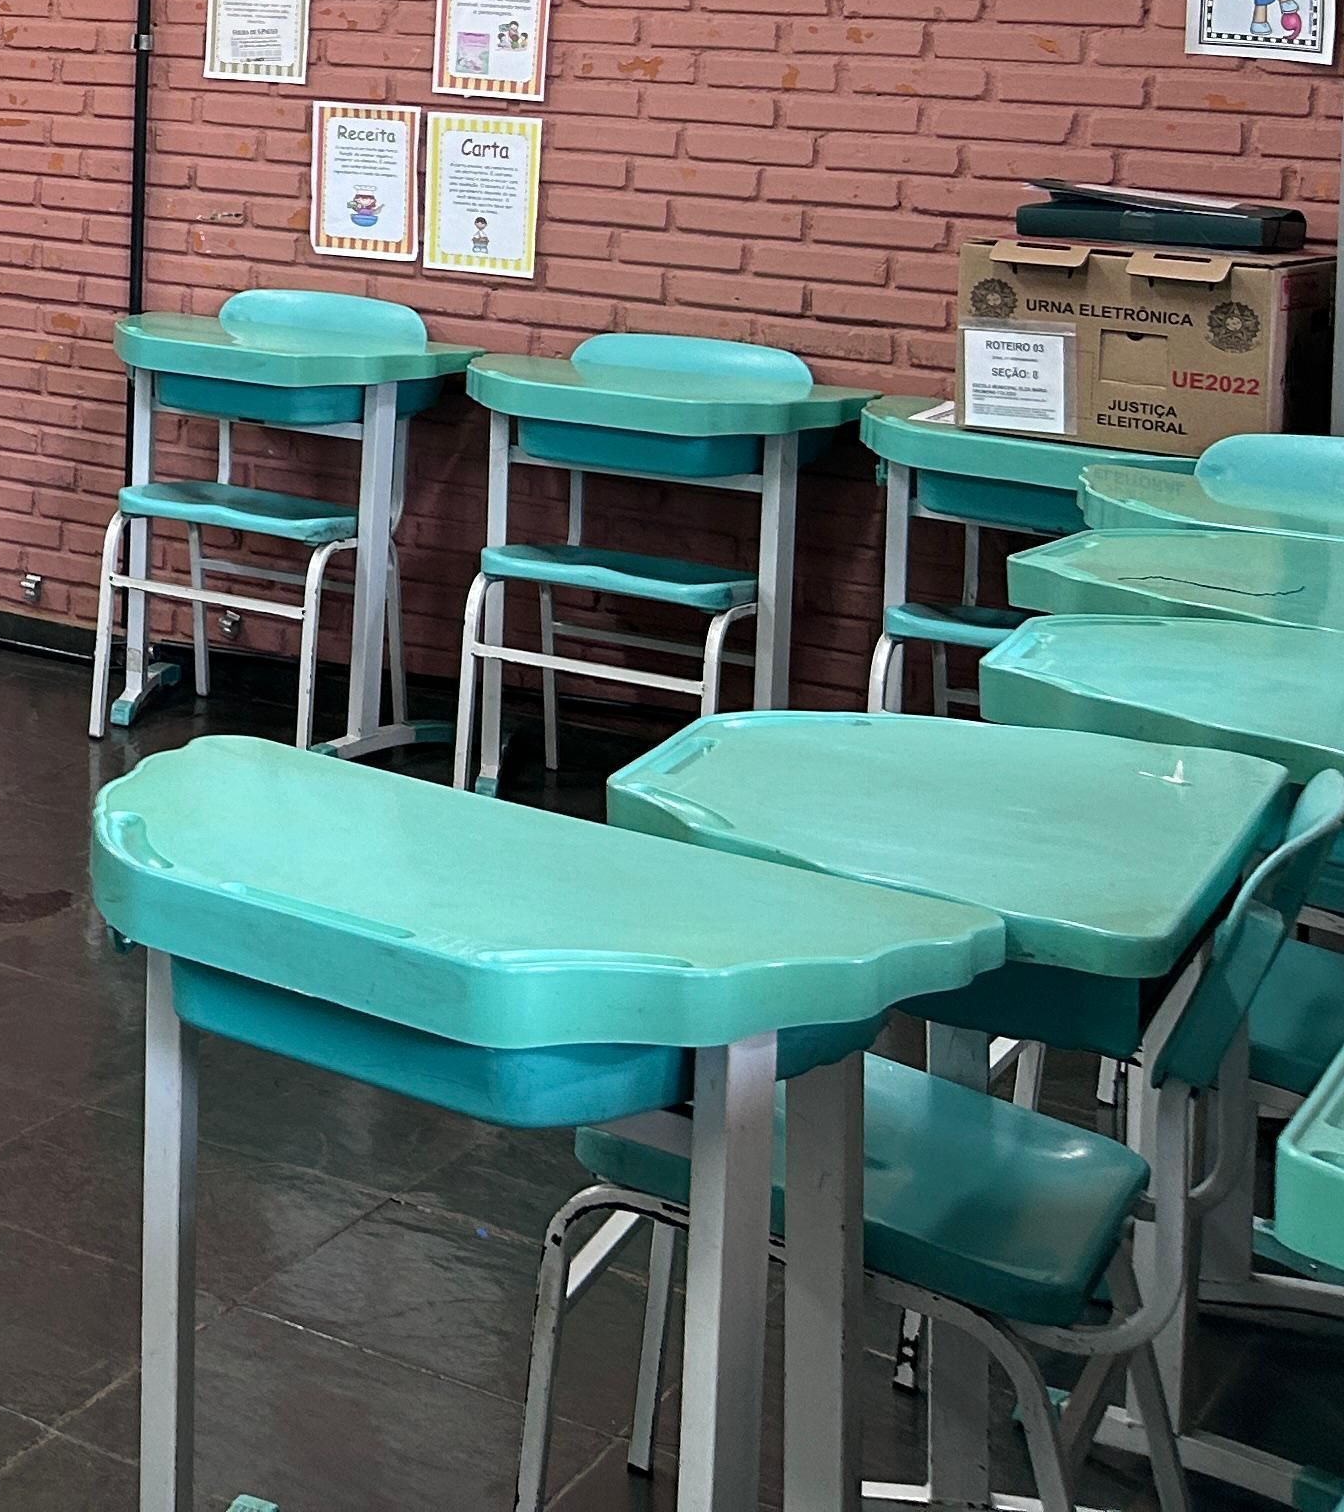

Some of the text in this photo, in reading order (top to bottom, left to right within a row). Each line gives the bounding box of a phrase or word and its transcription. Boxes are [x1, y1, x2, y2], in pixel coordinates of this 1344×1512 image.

[337, 125, 396, 143] Receita
[461, 138, 510, 159] Carta
[1026, 298, 1194, 327] URNA ELETRÔNICA
[985, 340, 1045, 353] ROTEIRO 03
[991, 366, 1030, 379] SEÇÃO:
[1171, 370, 1260, 396] UE2022
[1108, 399, 1178, 420] JUSTIÇA
[1096, 414, 1189, 435] ELEITORAL
